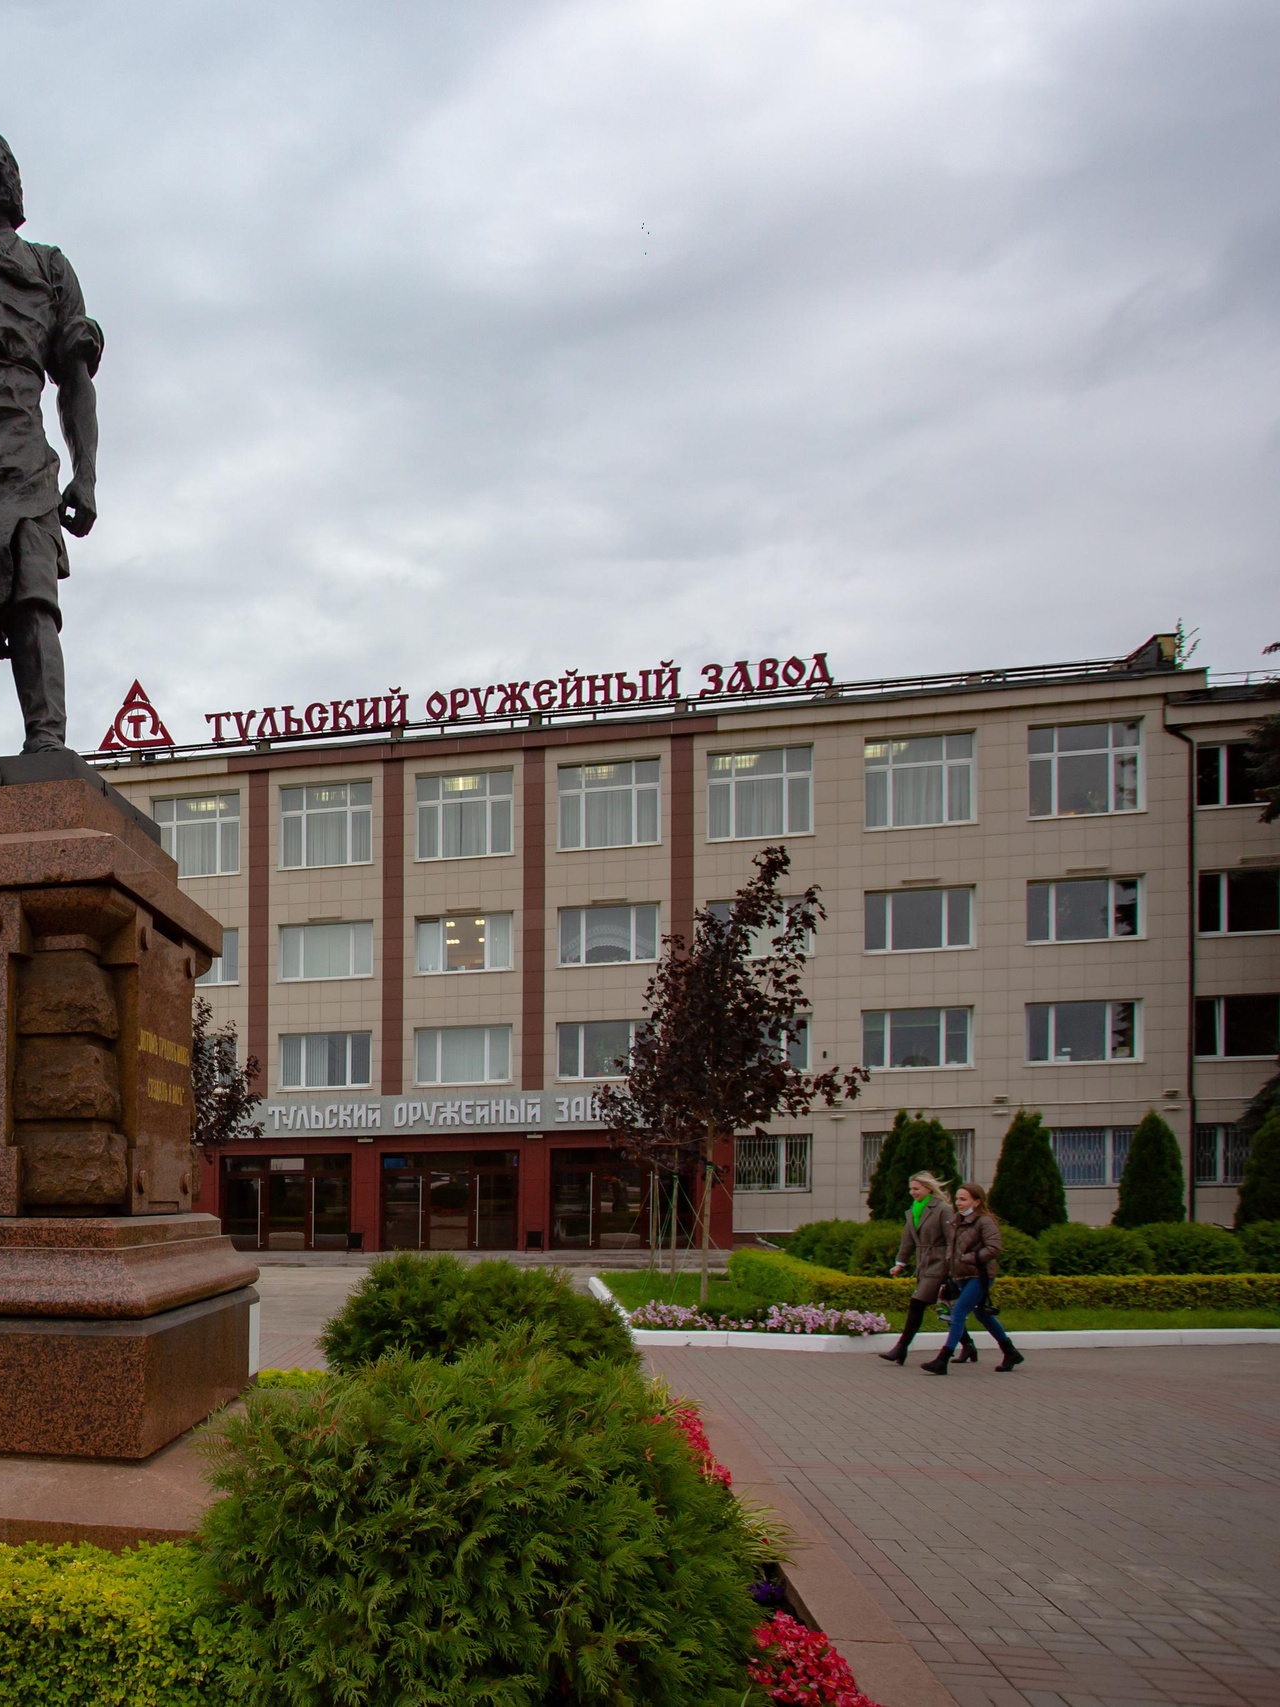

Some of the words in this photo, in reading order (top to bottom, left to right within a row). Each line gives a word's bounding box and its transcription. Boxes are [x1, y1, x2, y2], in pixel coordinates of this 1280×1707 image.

[205, 687, 409, 745] ТУЛЬСКИЙ
[426, 659, 681, 722] ОРУЖЕЙНЫЙ
[699, 652, 834, 698] ЗАВОД
[267, 1103, 381, 1130] ТУЛЬСКИЙ
[393, 1098, 541, 1127] ОРУЖЕЙНЫЙ
[555, 1096, 617, 1122] ЗАВ
